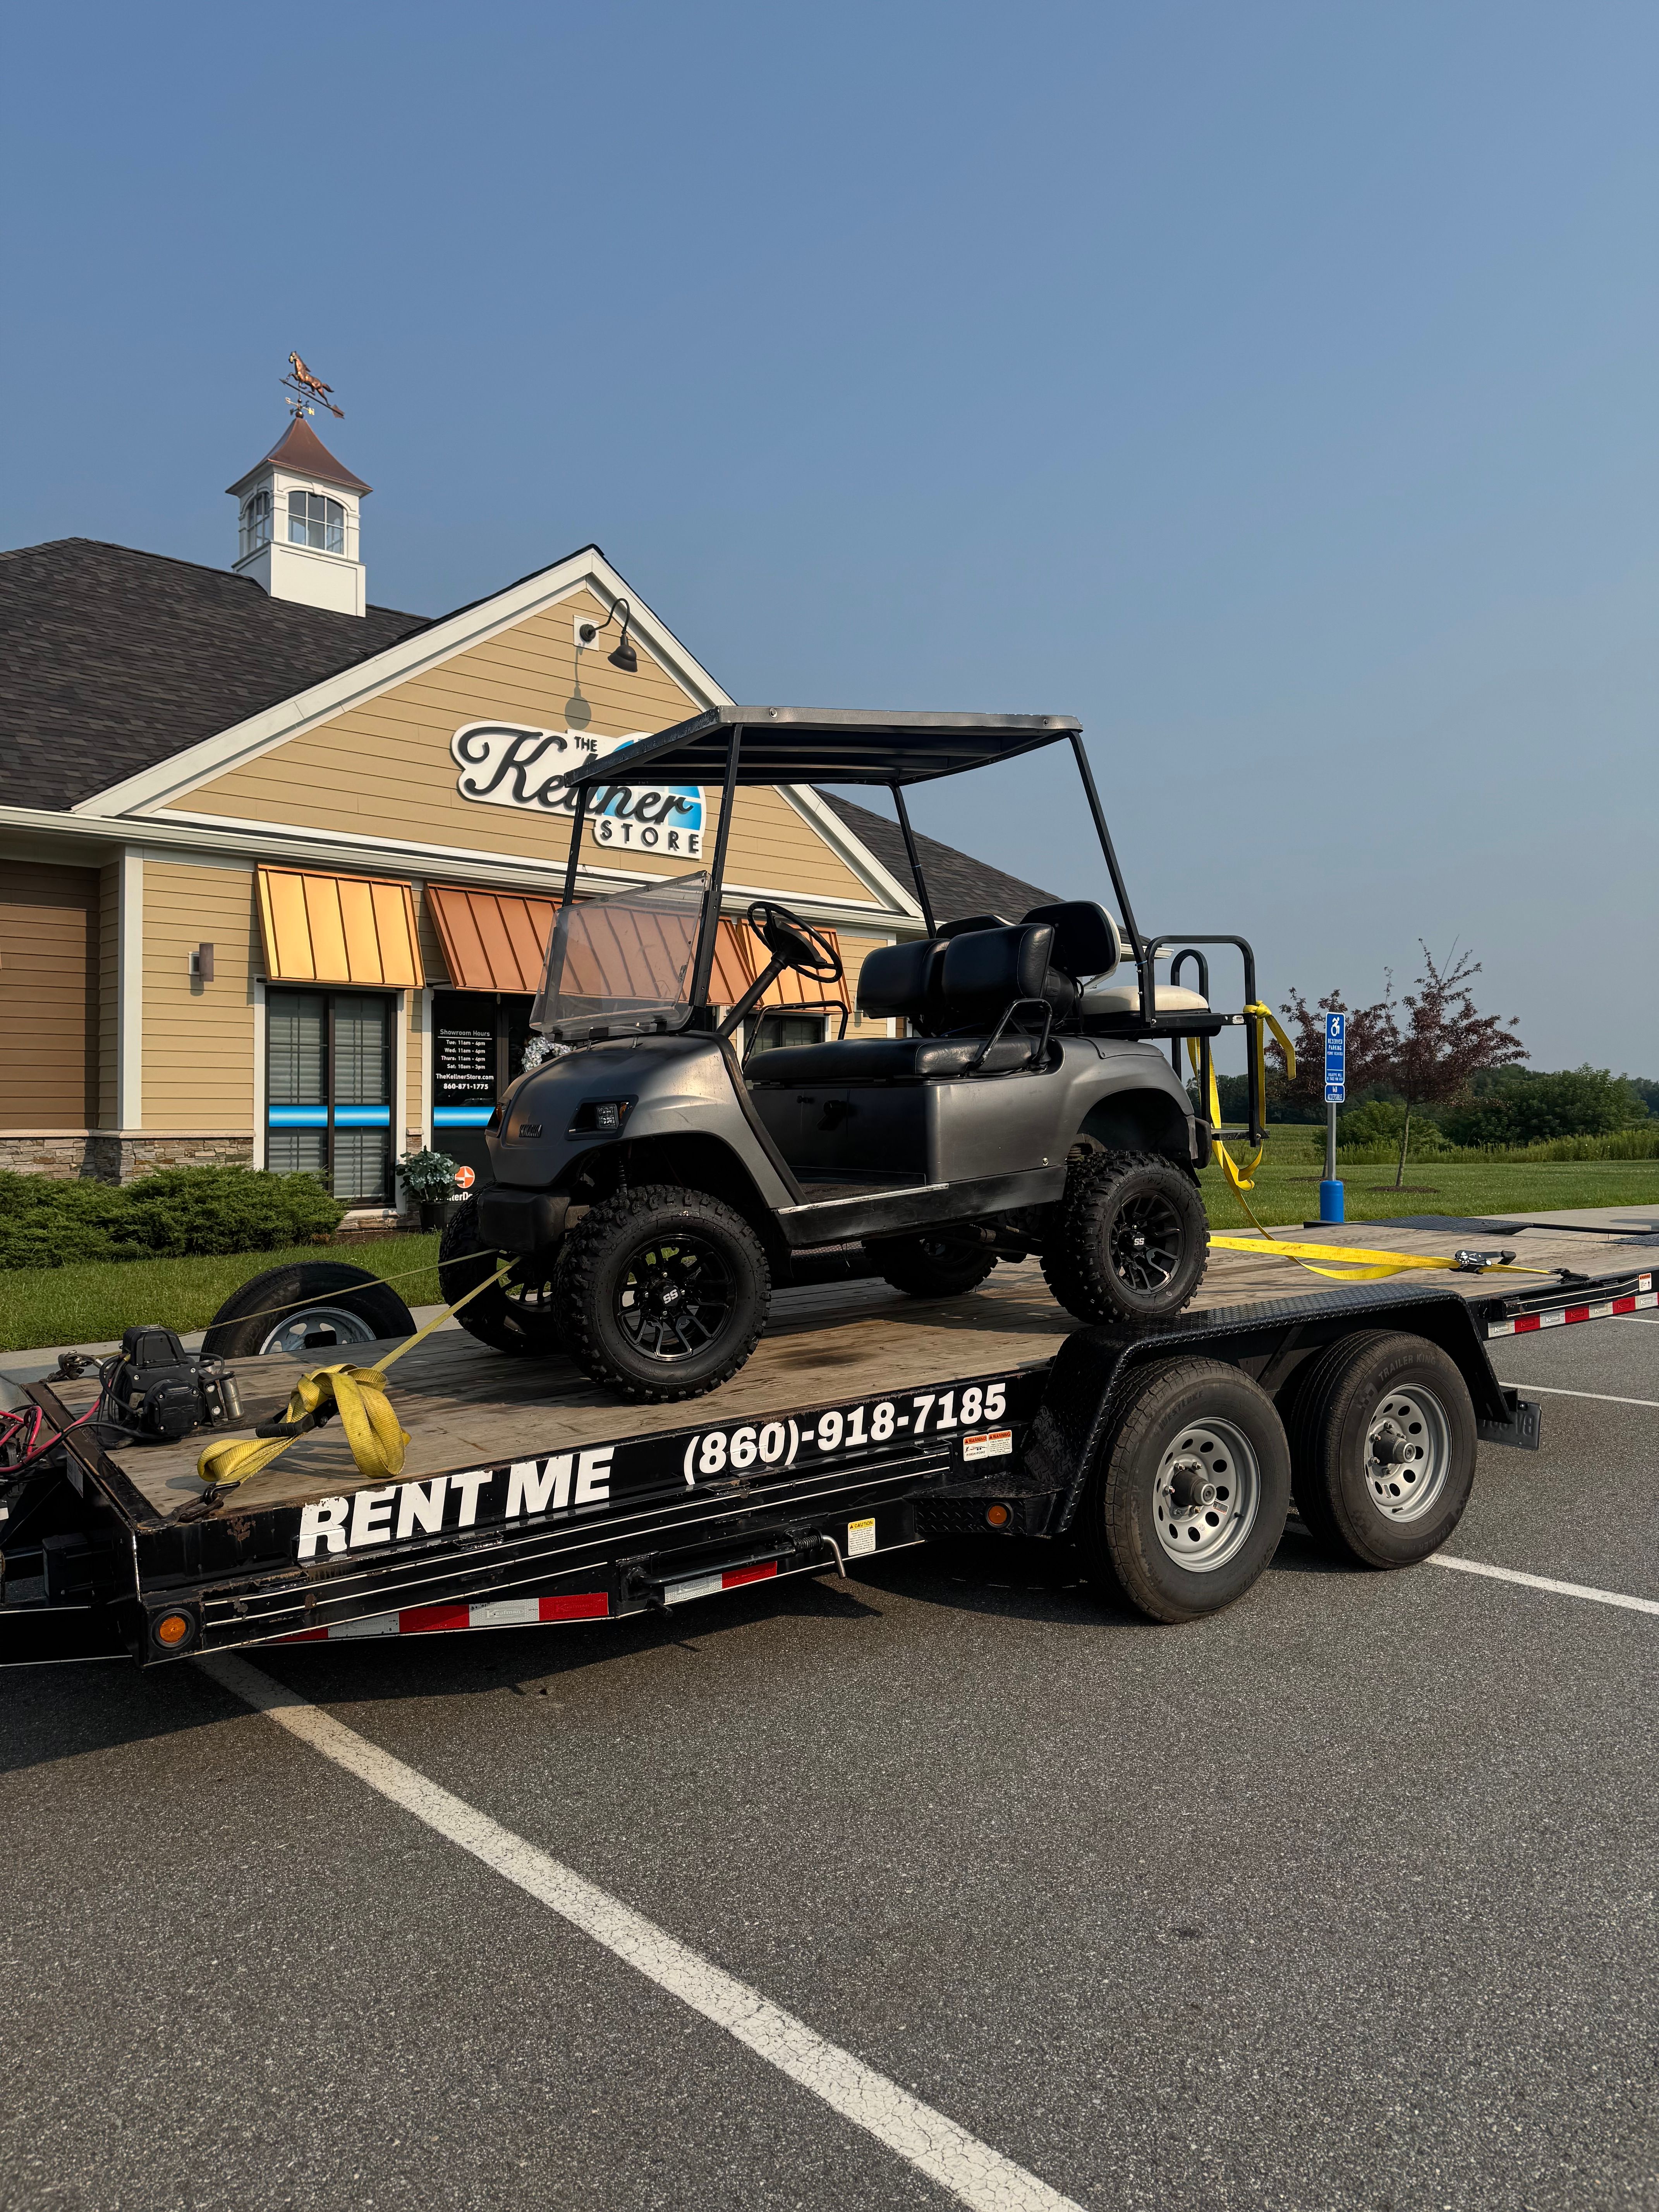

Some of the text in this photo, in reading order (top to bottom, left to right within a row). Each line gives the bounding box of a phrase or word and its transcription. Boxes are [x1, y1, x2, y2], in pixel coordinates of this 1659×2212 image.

[574, 736, 598, 752] THE
[601, 819, 699, 854] STORE
[1134, 1238, 1145, 1246] SS
[663, 1289, 678, 1304] SS
[1379, 1355, 1413, 1381] TRAILER
[1417, 1353, 1436, 1365] KING
[684, 1382, 1006, 1485] (860)-918-7185
[298, 1447, 615, 1559] RENT ME
[486, 1609, 523, 1619] Kaufman
